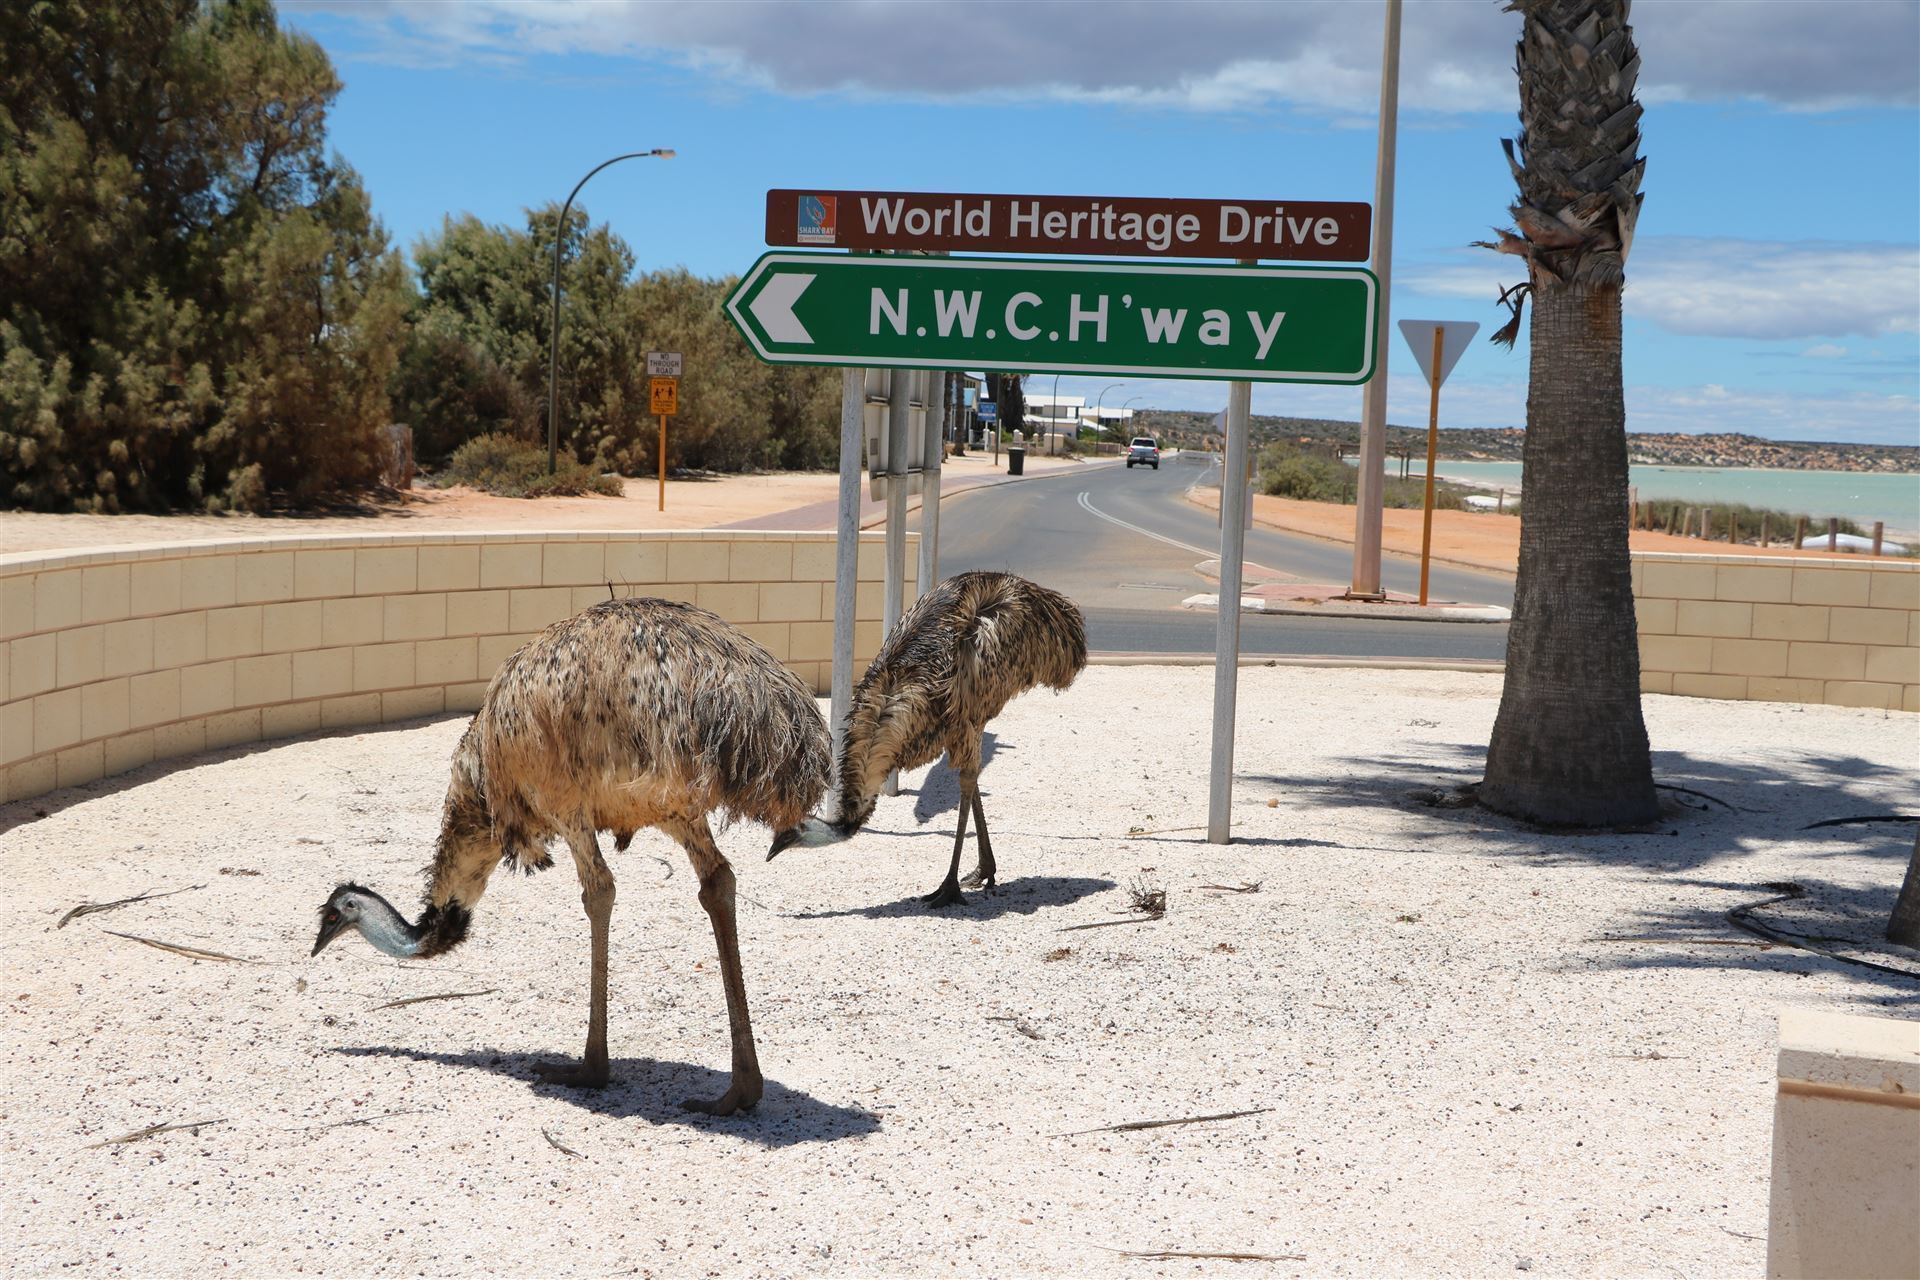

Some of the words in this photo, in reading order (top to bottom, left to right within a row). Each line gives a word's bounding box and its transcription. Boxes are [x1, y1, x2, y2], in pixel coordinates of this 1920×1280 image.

[860, 197, 991, 238] World
[1009, 201, 1201, 251] Heritage
[1219, 206, 1340, 246] Drive
[821, 227, 834, 235] BAY
[650, 360, 679, 368] THROUGH
